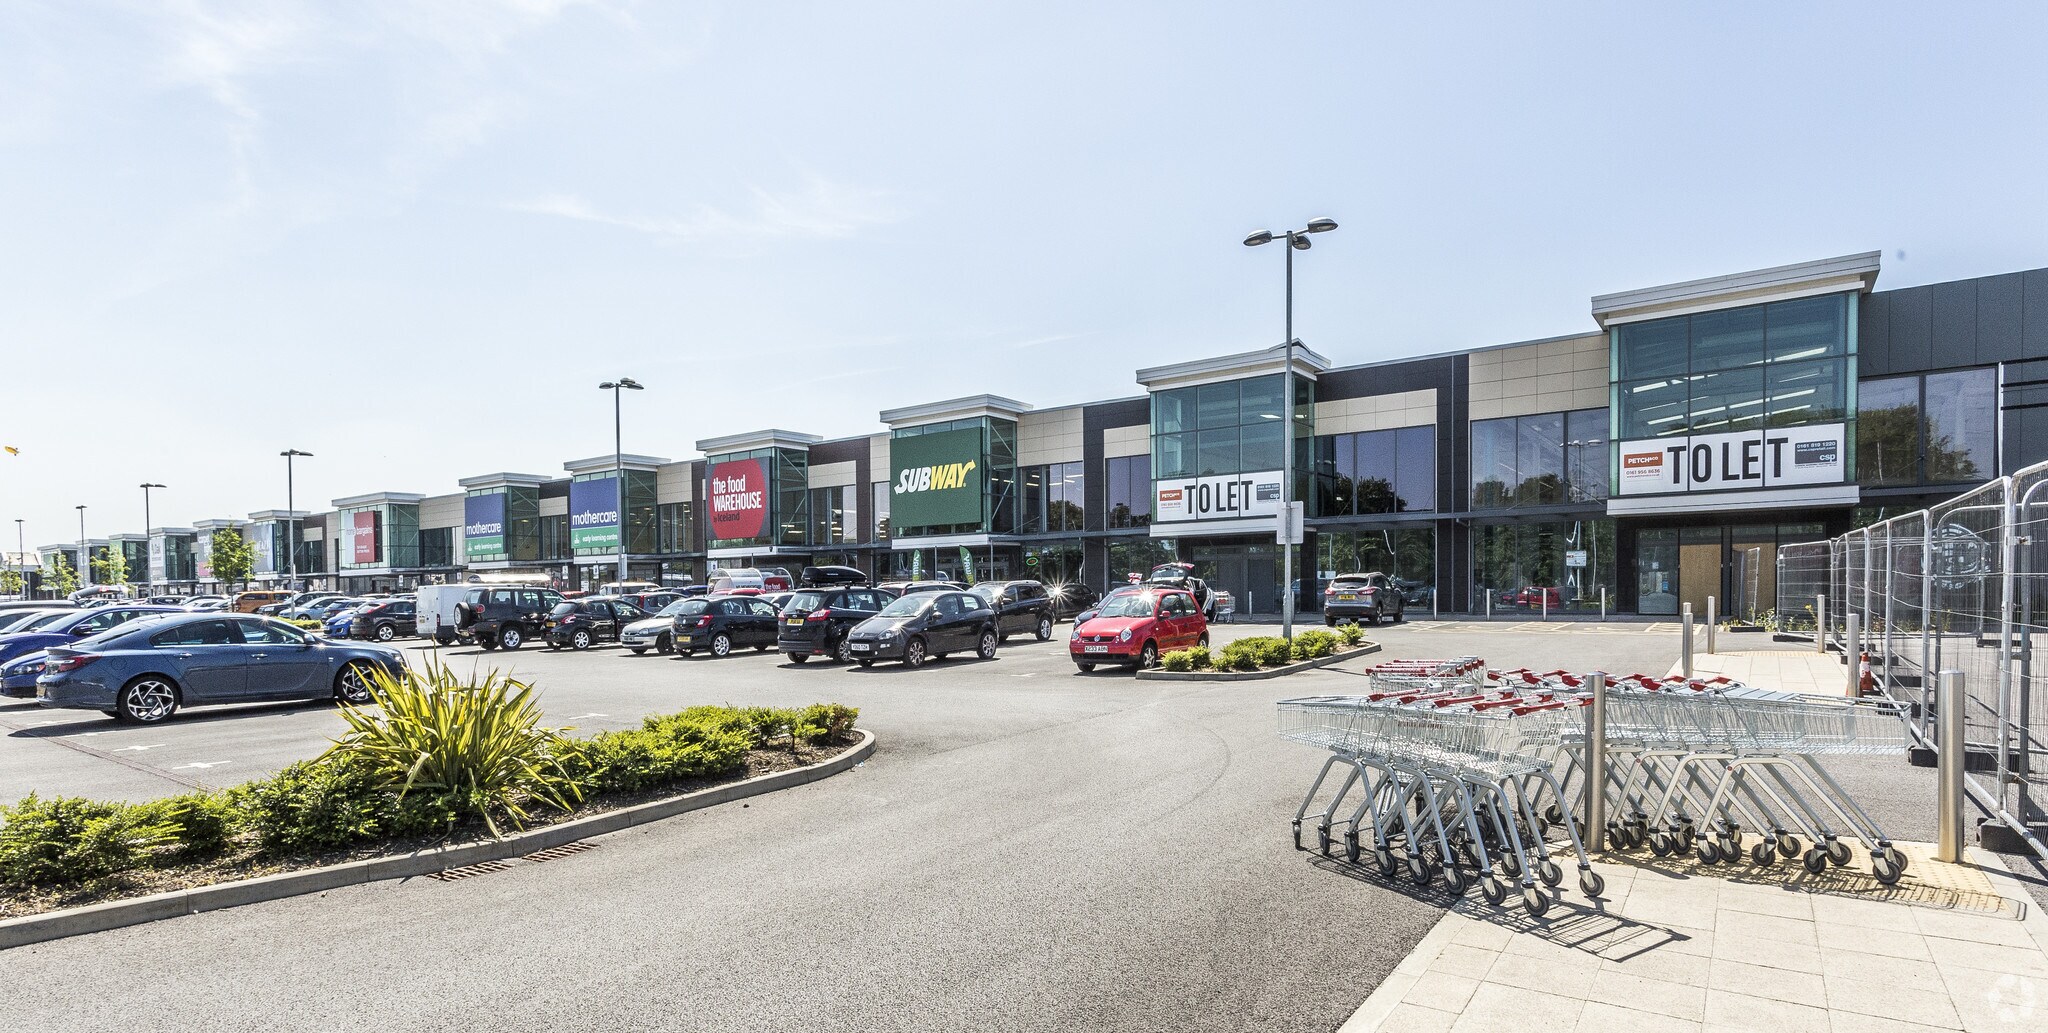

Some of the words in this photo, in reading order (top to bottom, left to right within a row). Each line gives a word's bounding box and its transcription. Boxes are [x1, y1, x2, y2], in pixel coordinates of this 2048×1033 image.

[1667, 443, 1712, 484] TO
[1721, 437, 1789, 481] LET
[713, 477, 726, 495] the
[727, 474, 746, 493] food
[894, 459, 976, 495] SUBWAY
[713, 491, 763, 512] WAREHOUSE
[1184, 483, 1211, 514] TO
[1215, 480, 1253, 512] LET
[572, 509, 618, 525] mothercare
[466, 521, 502, 535] mothercare
